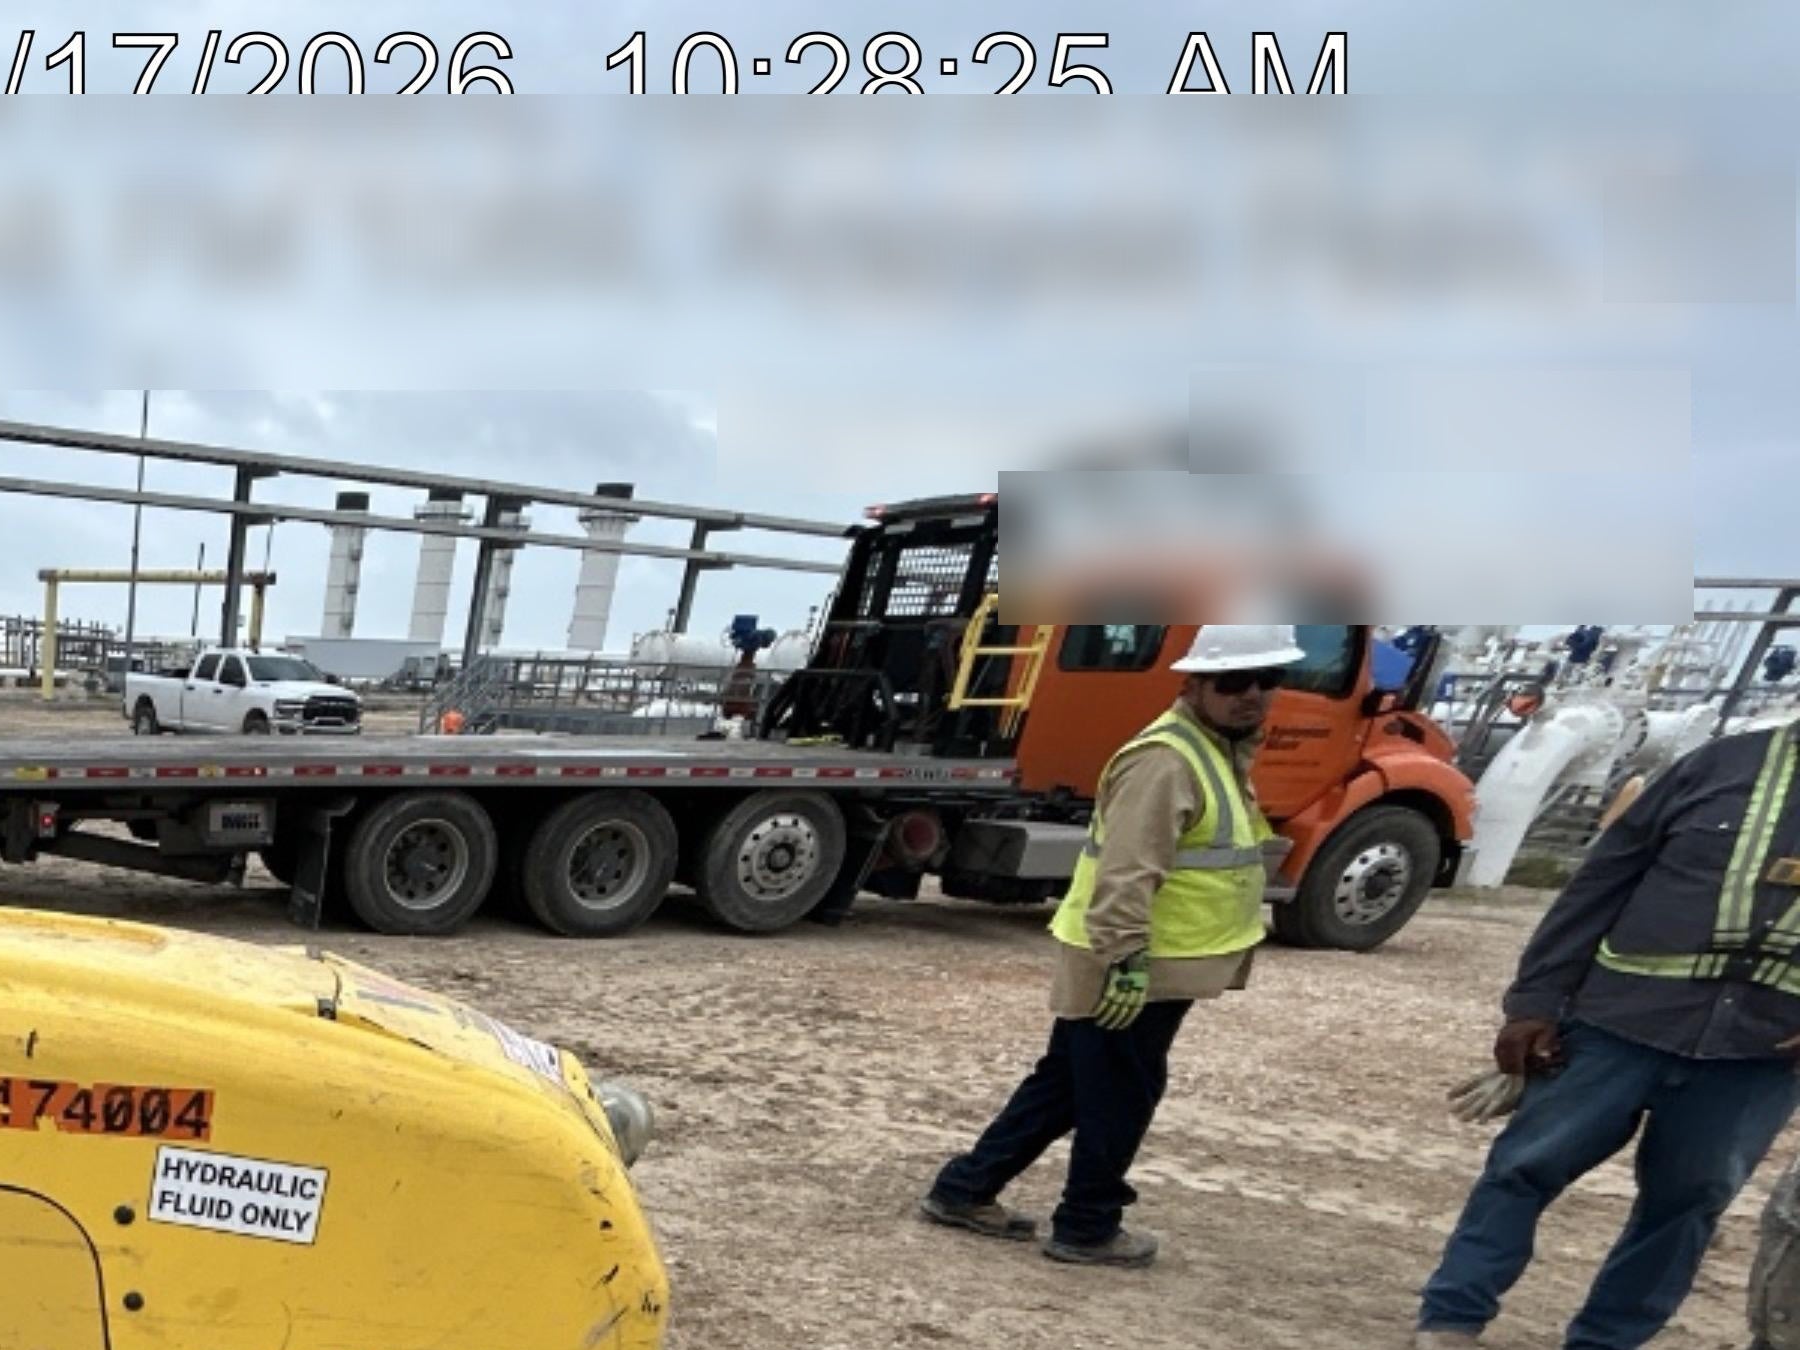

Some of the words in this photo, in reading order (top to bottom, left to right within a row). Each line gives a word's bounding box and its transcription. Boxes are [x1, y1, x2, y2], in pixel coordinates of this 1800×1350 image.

[161, 1156, 319, 1201] HYDRAULIC
[158, 1190, 233, 1221] FLUID
[239, 1203, 313, 1233] ONLY
